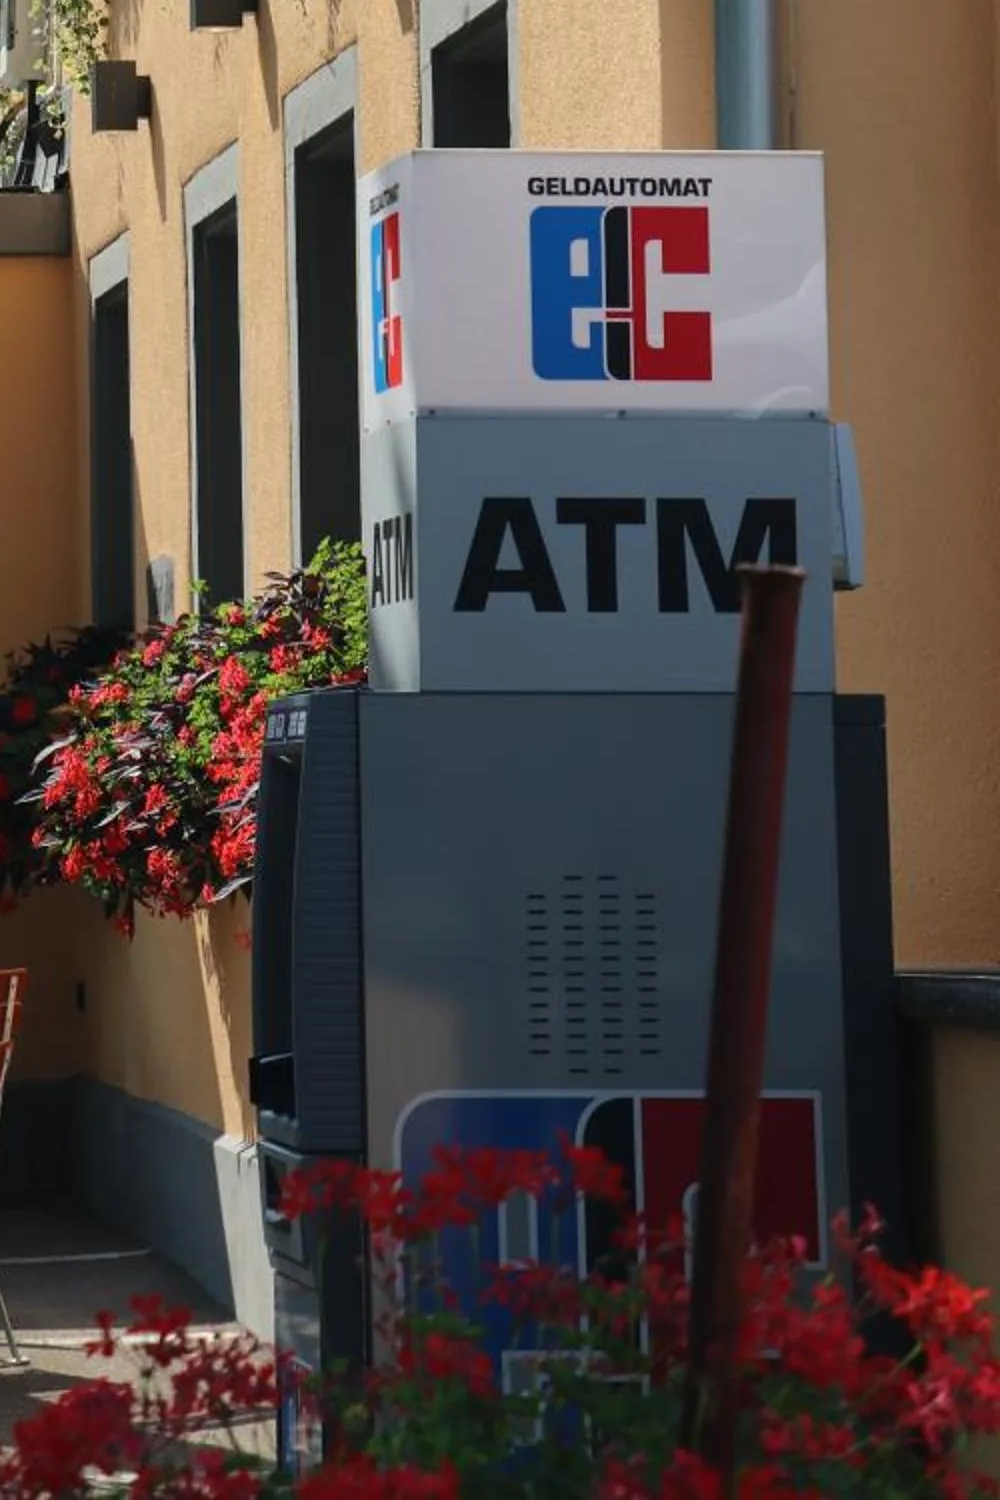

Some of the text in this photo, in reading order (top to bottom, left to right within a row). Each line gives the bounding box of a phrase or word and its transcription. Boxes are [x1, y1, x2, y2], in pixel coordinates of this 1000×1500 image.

[527, 177, 712, 196] GELDAUTOMAT
[371, 512, 413, 608] ATM
[453, 497, 797, 613] ATM
